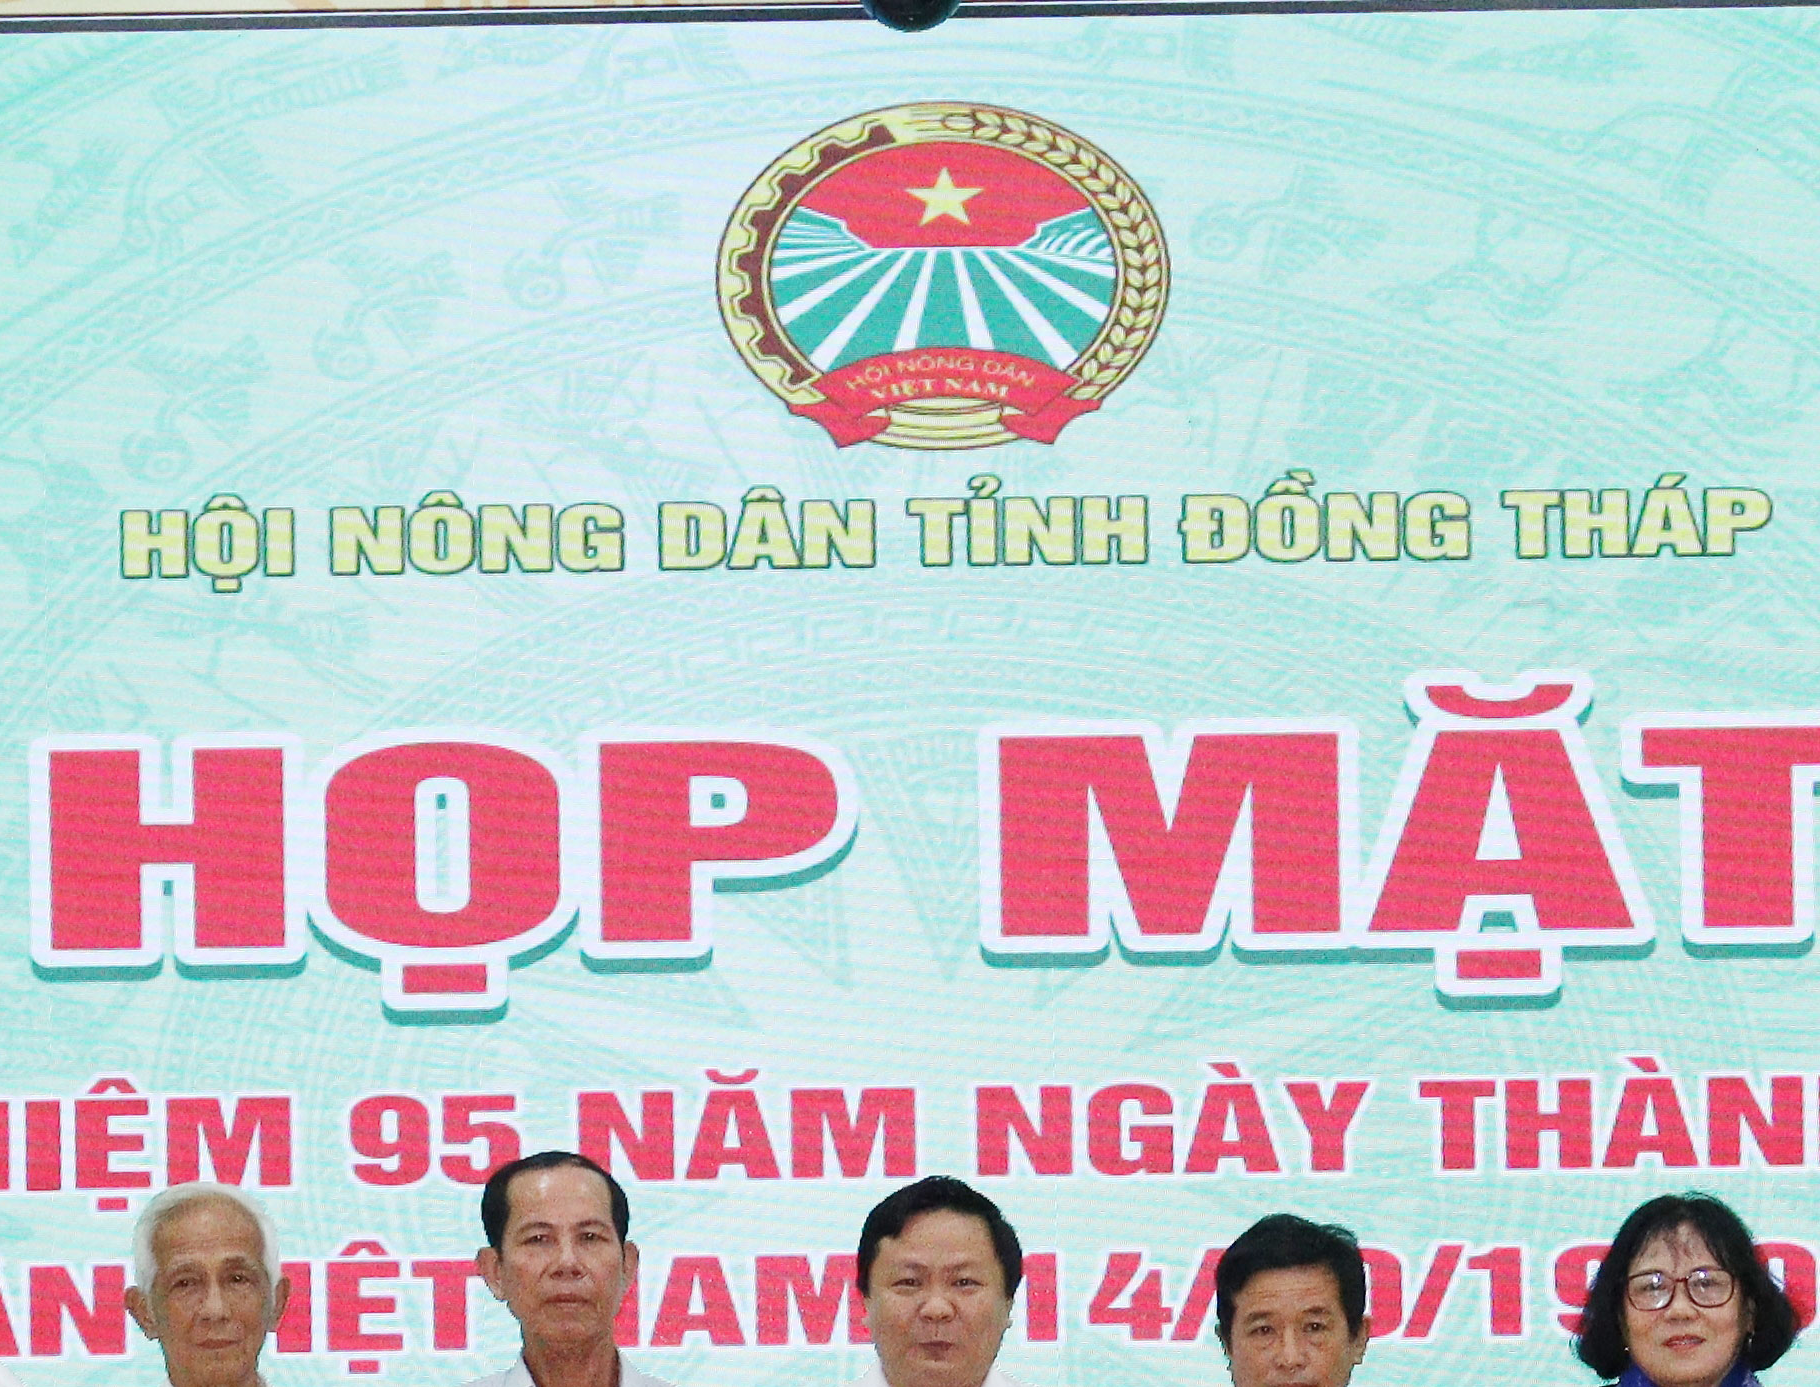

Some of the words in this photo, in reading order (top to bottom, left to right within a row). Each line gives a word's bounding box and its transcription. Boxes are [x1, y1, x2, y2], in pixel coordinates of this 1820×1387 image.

[119, 492, 295, 594] HỘI
[329, 490, 626, 577] NÔNG
[657, 486, 878, 571] DÂN
[905, 475, 1150, 568] TỈNH
[1177, 471, 1472, 564] ĐỒNG
[1500, 473, 1774, 559] THÁP
[47, 740, 840, 996] HỌP
[349, 1095, 523, 1186] 95
[577, 1069, 918, 1182] NĂM
[976, 1062, 1370, 1176] NGÀY
[276, 1241, 484, 1375] IỆT
